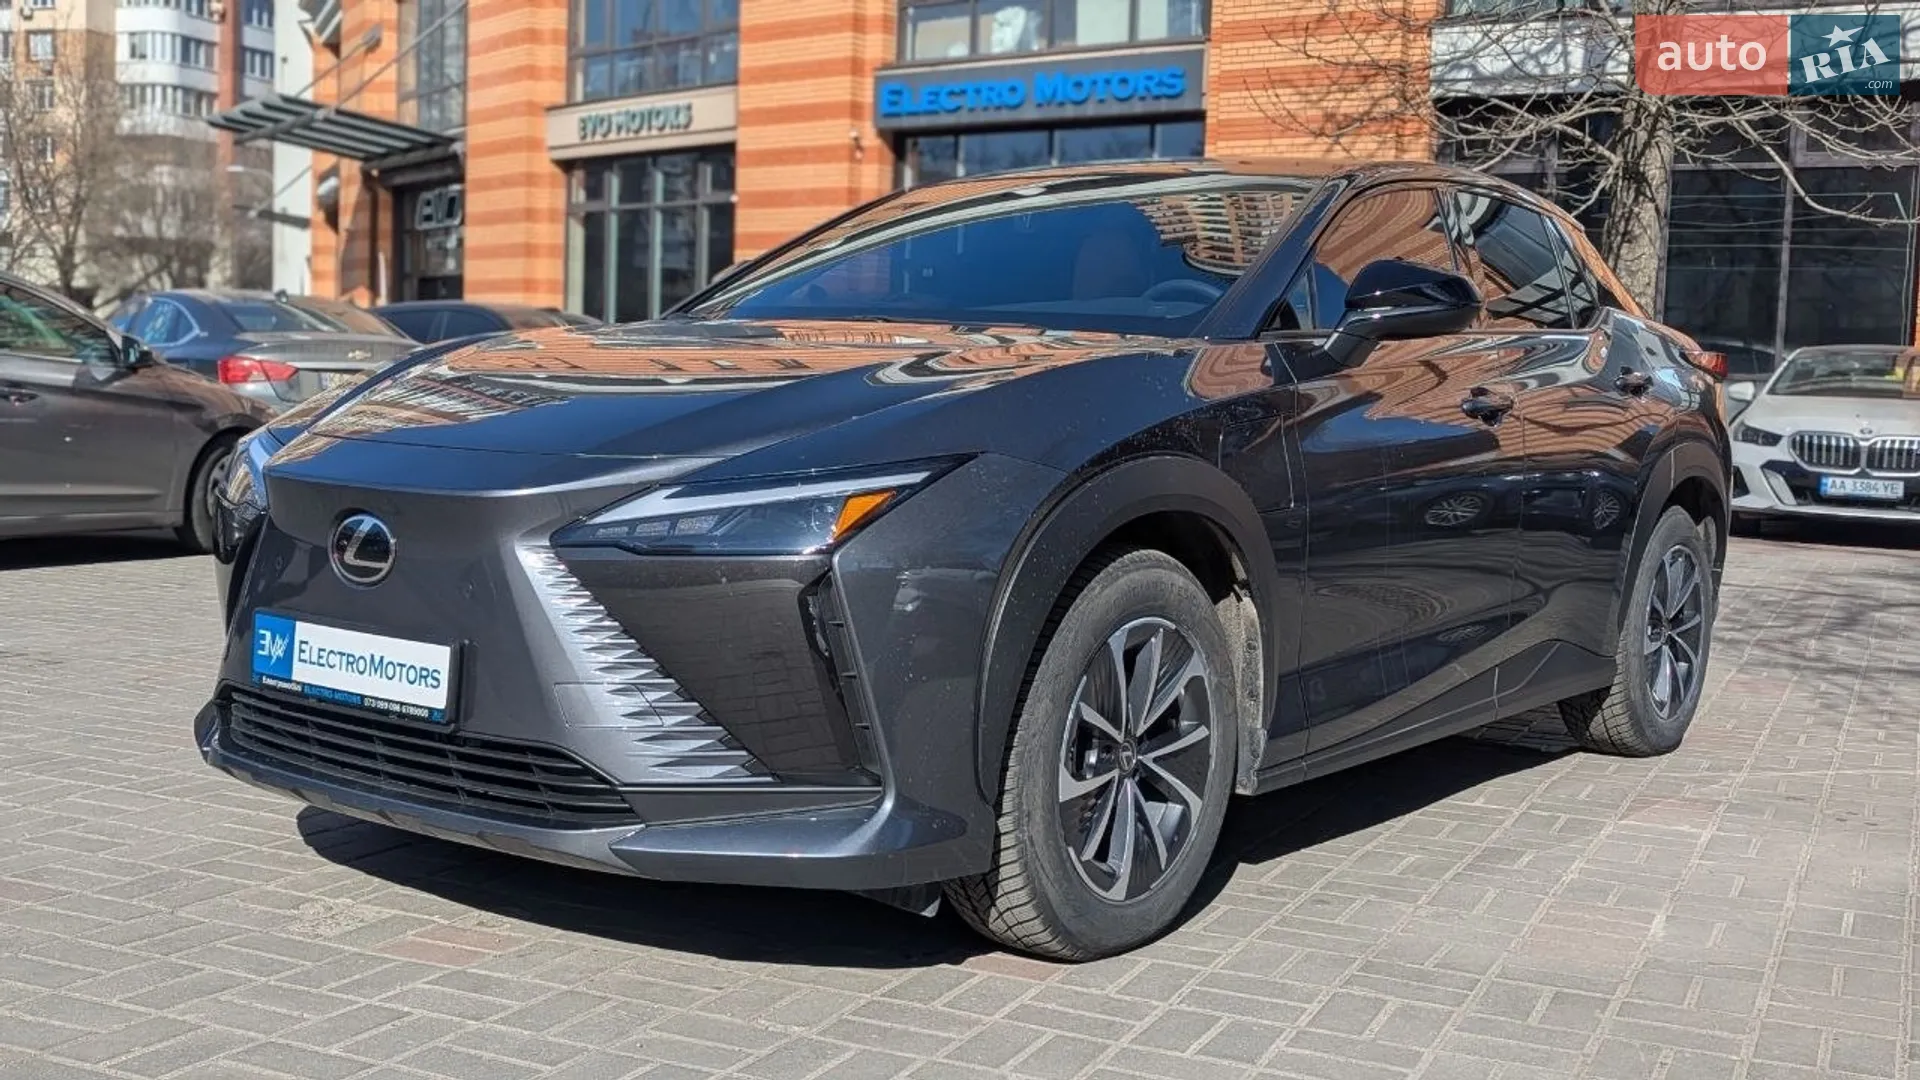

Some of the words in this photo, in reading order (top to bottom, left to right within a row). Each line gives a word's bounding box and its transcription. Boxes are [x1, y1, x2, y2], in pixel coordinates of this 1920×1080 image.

[880, 79, 1027, 116] ELECTRO
[1034, 67, 1186, 108] MOTORS
[578, 113, 612, 140] EVO
[614, 103, 693, 136] MOTORS
[1830, 480, 1847, 490] AA
